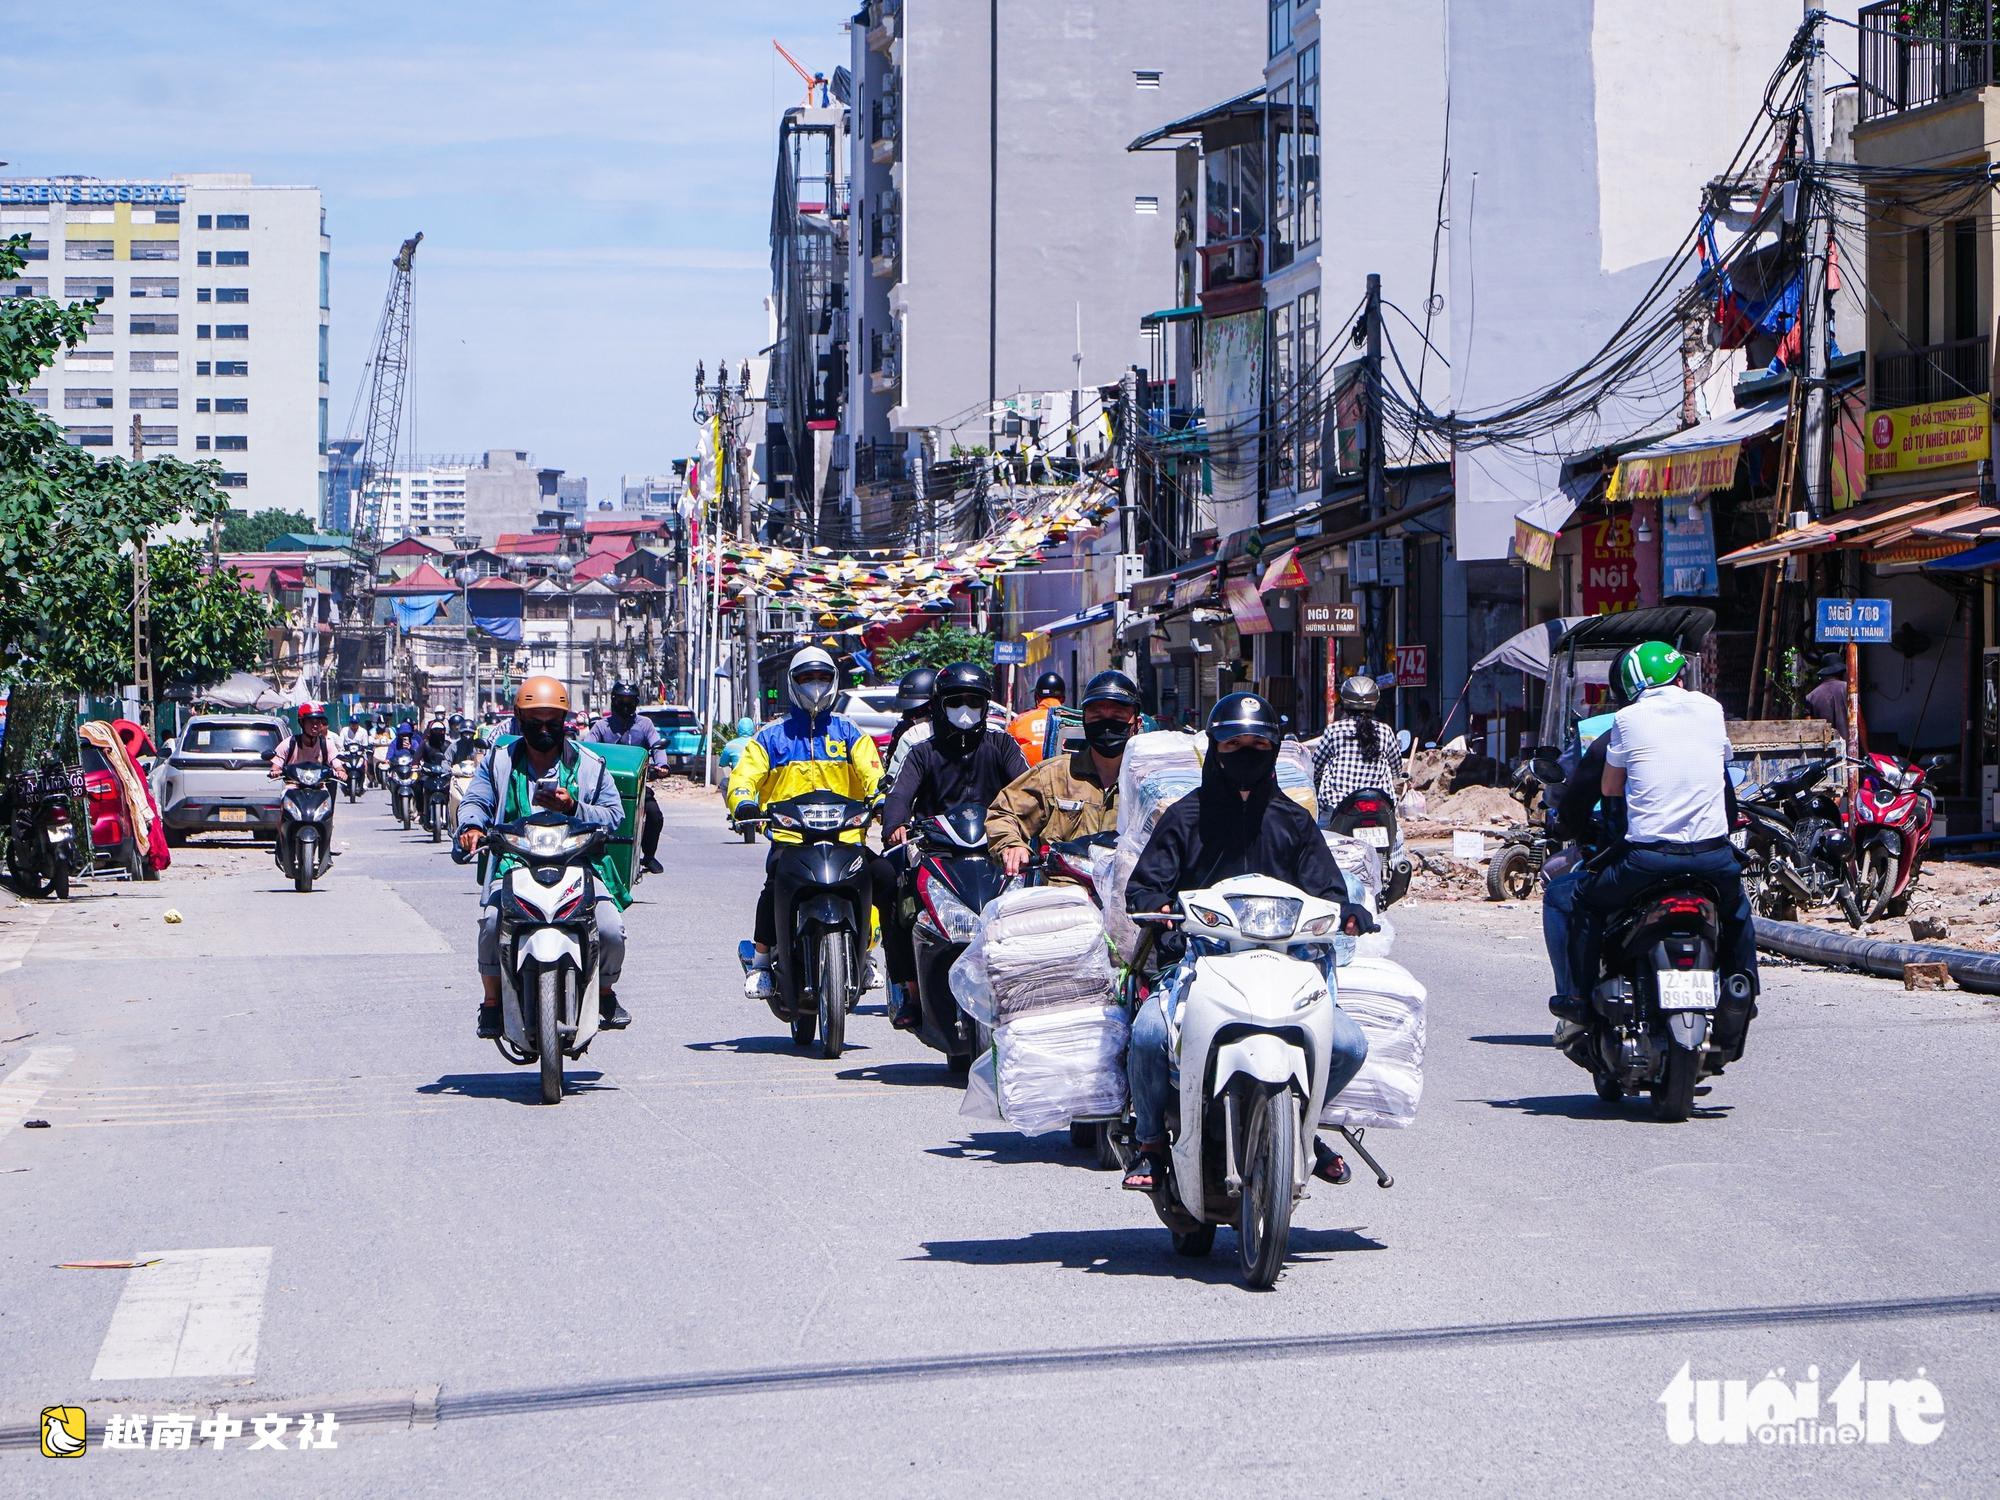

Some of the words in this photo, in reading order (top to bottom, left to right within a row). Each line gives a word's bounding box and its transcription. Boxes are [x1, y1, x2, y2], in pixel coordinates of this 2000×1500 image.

[89, 185, 186, 203] HOSPITAL
[1933, 408, 1957, 424] TRUNG
[1915, 433, 1925, 453] TỰ
[1926, 429, 1949, 448] NHIÊN
[1951, 429, 1966, 444] CAO
[1968, 423, 1984, 442] CẤP
[1595, 549, 1608, 558] La
[1590, 564, 1628, 593] Nội
[1334, 608, 1354, 620] 720
[1828, 602, 1852, 620] NGÕ
[1857, 606, 1879, 621] 708
[1825, 624, 1849, 637] ĐƯỜNG
[1851, 627, 1859, 636] LA
[1861, 624, 1883, 637] THÀNH
[1397, 649, 1424, 675] 742
[825, 735, 847, 758] be
